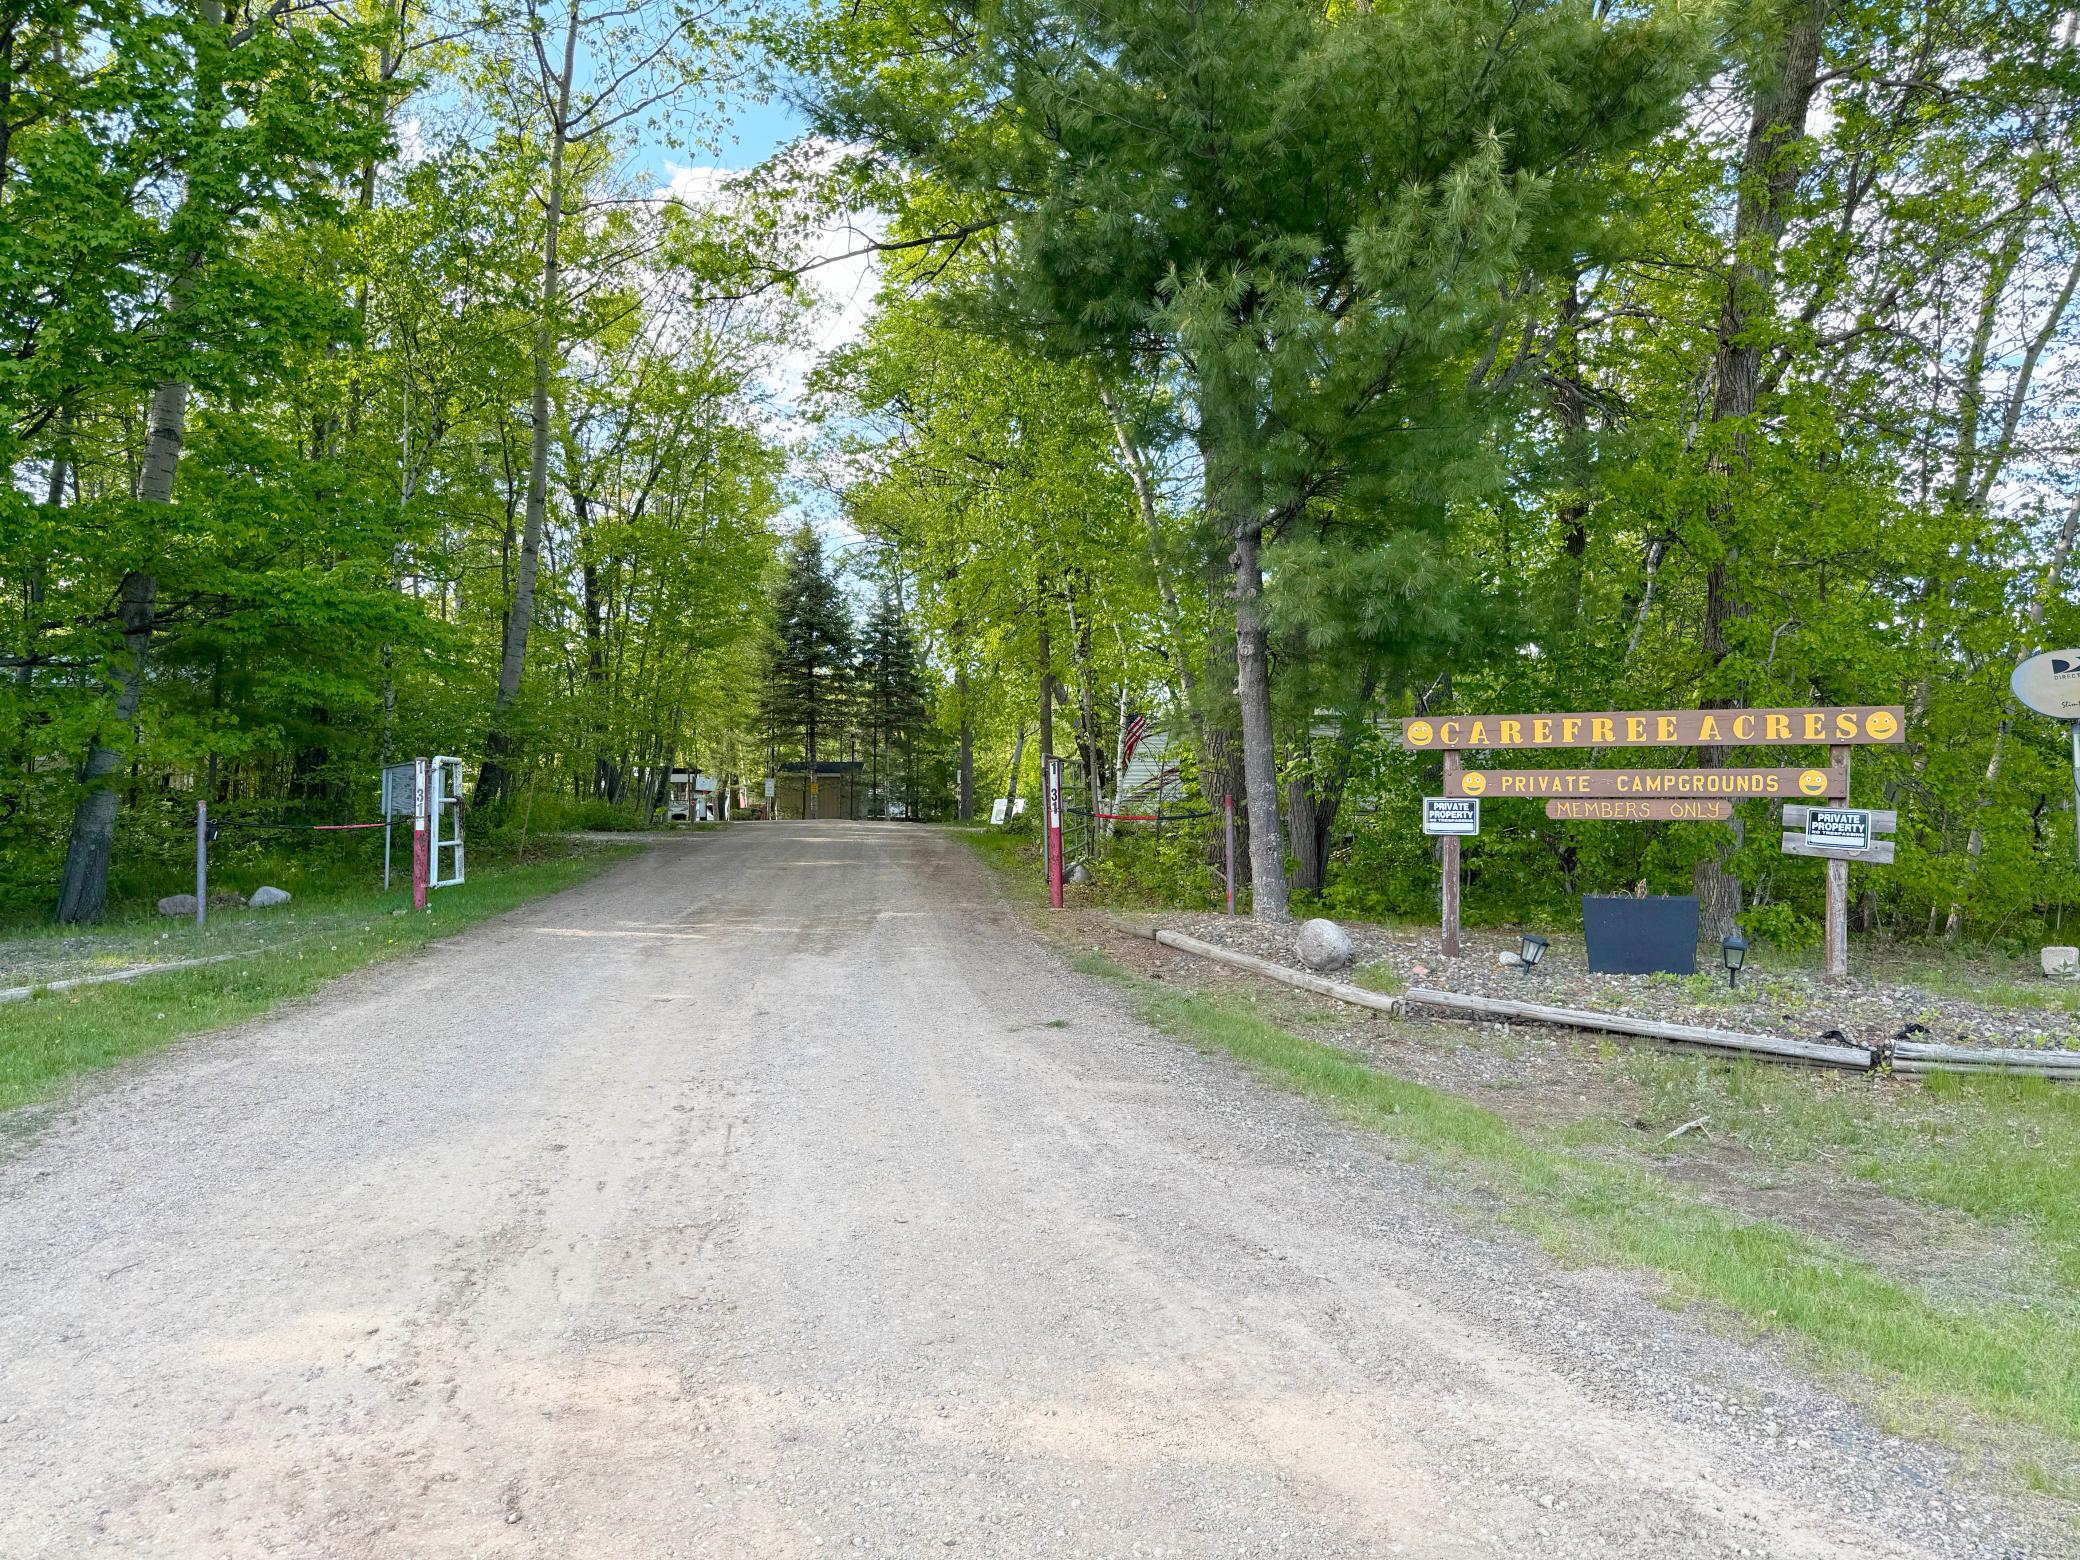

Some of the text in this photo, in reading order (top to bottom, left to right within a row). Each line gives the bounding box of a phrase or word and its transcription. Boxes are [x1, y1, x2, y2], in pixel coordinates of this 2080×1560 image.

[1440, 713, 1858, 744] CAREFREE ACRES
[1501, 775, 1779, 792] PRIVATE CAMPGROUNDS
[1433, 802, 1470, 811] PRIVATE
[1556, 801, 1720, 818] MEMBERS ONLY
[1429, 810, 1474, 819] PROPERTY
[1817, 813, 1861, 824] PRIVATE
[1811, 821, 1865, 833] PROPERTY
